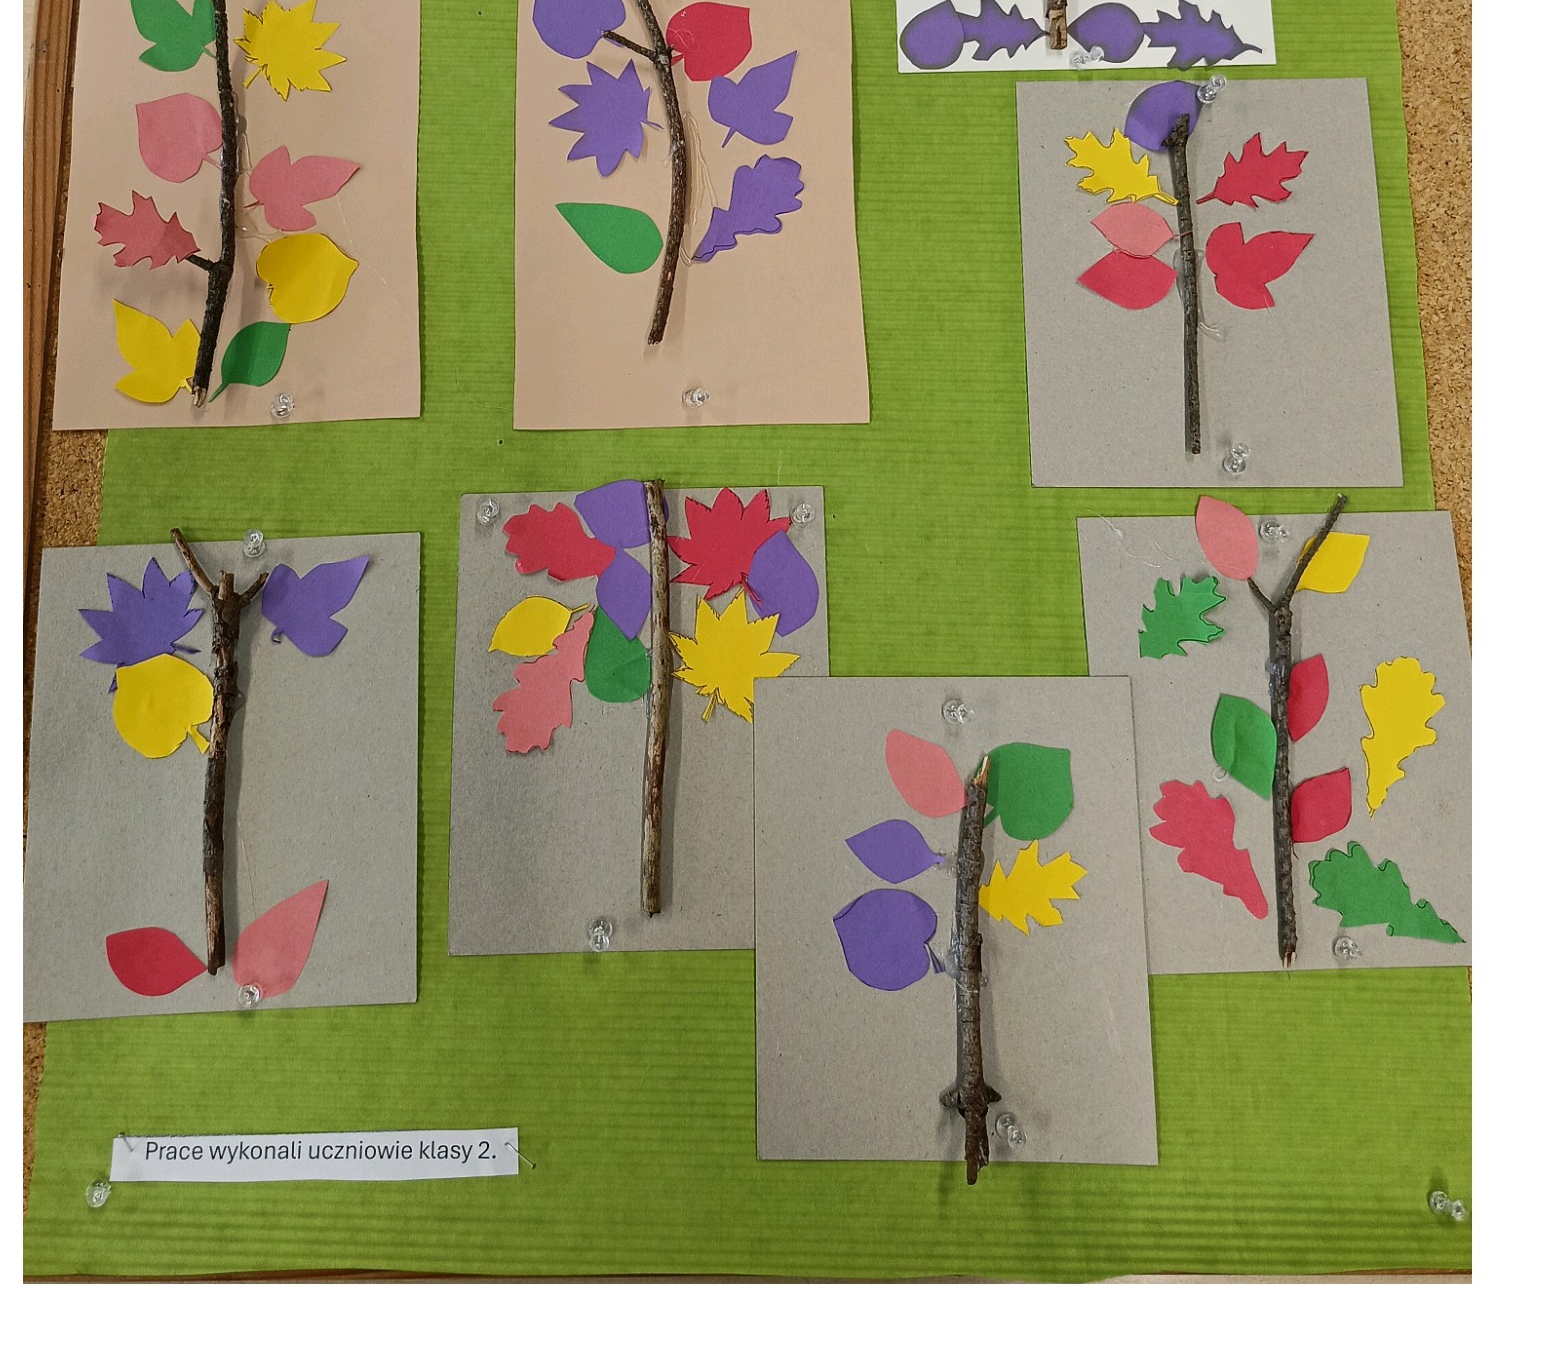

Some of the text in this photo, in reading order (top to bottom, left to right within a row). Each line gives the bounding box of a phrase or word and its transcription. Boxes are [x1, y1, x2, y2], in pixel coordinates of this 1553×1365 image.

[145, 1140, 496, 1165] Prace wykonali uczniowie klasy 2.
